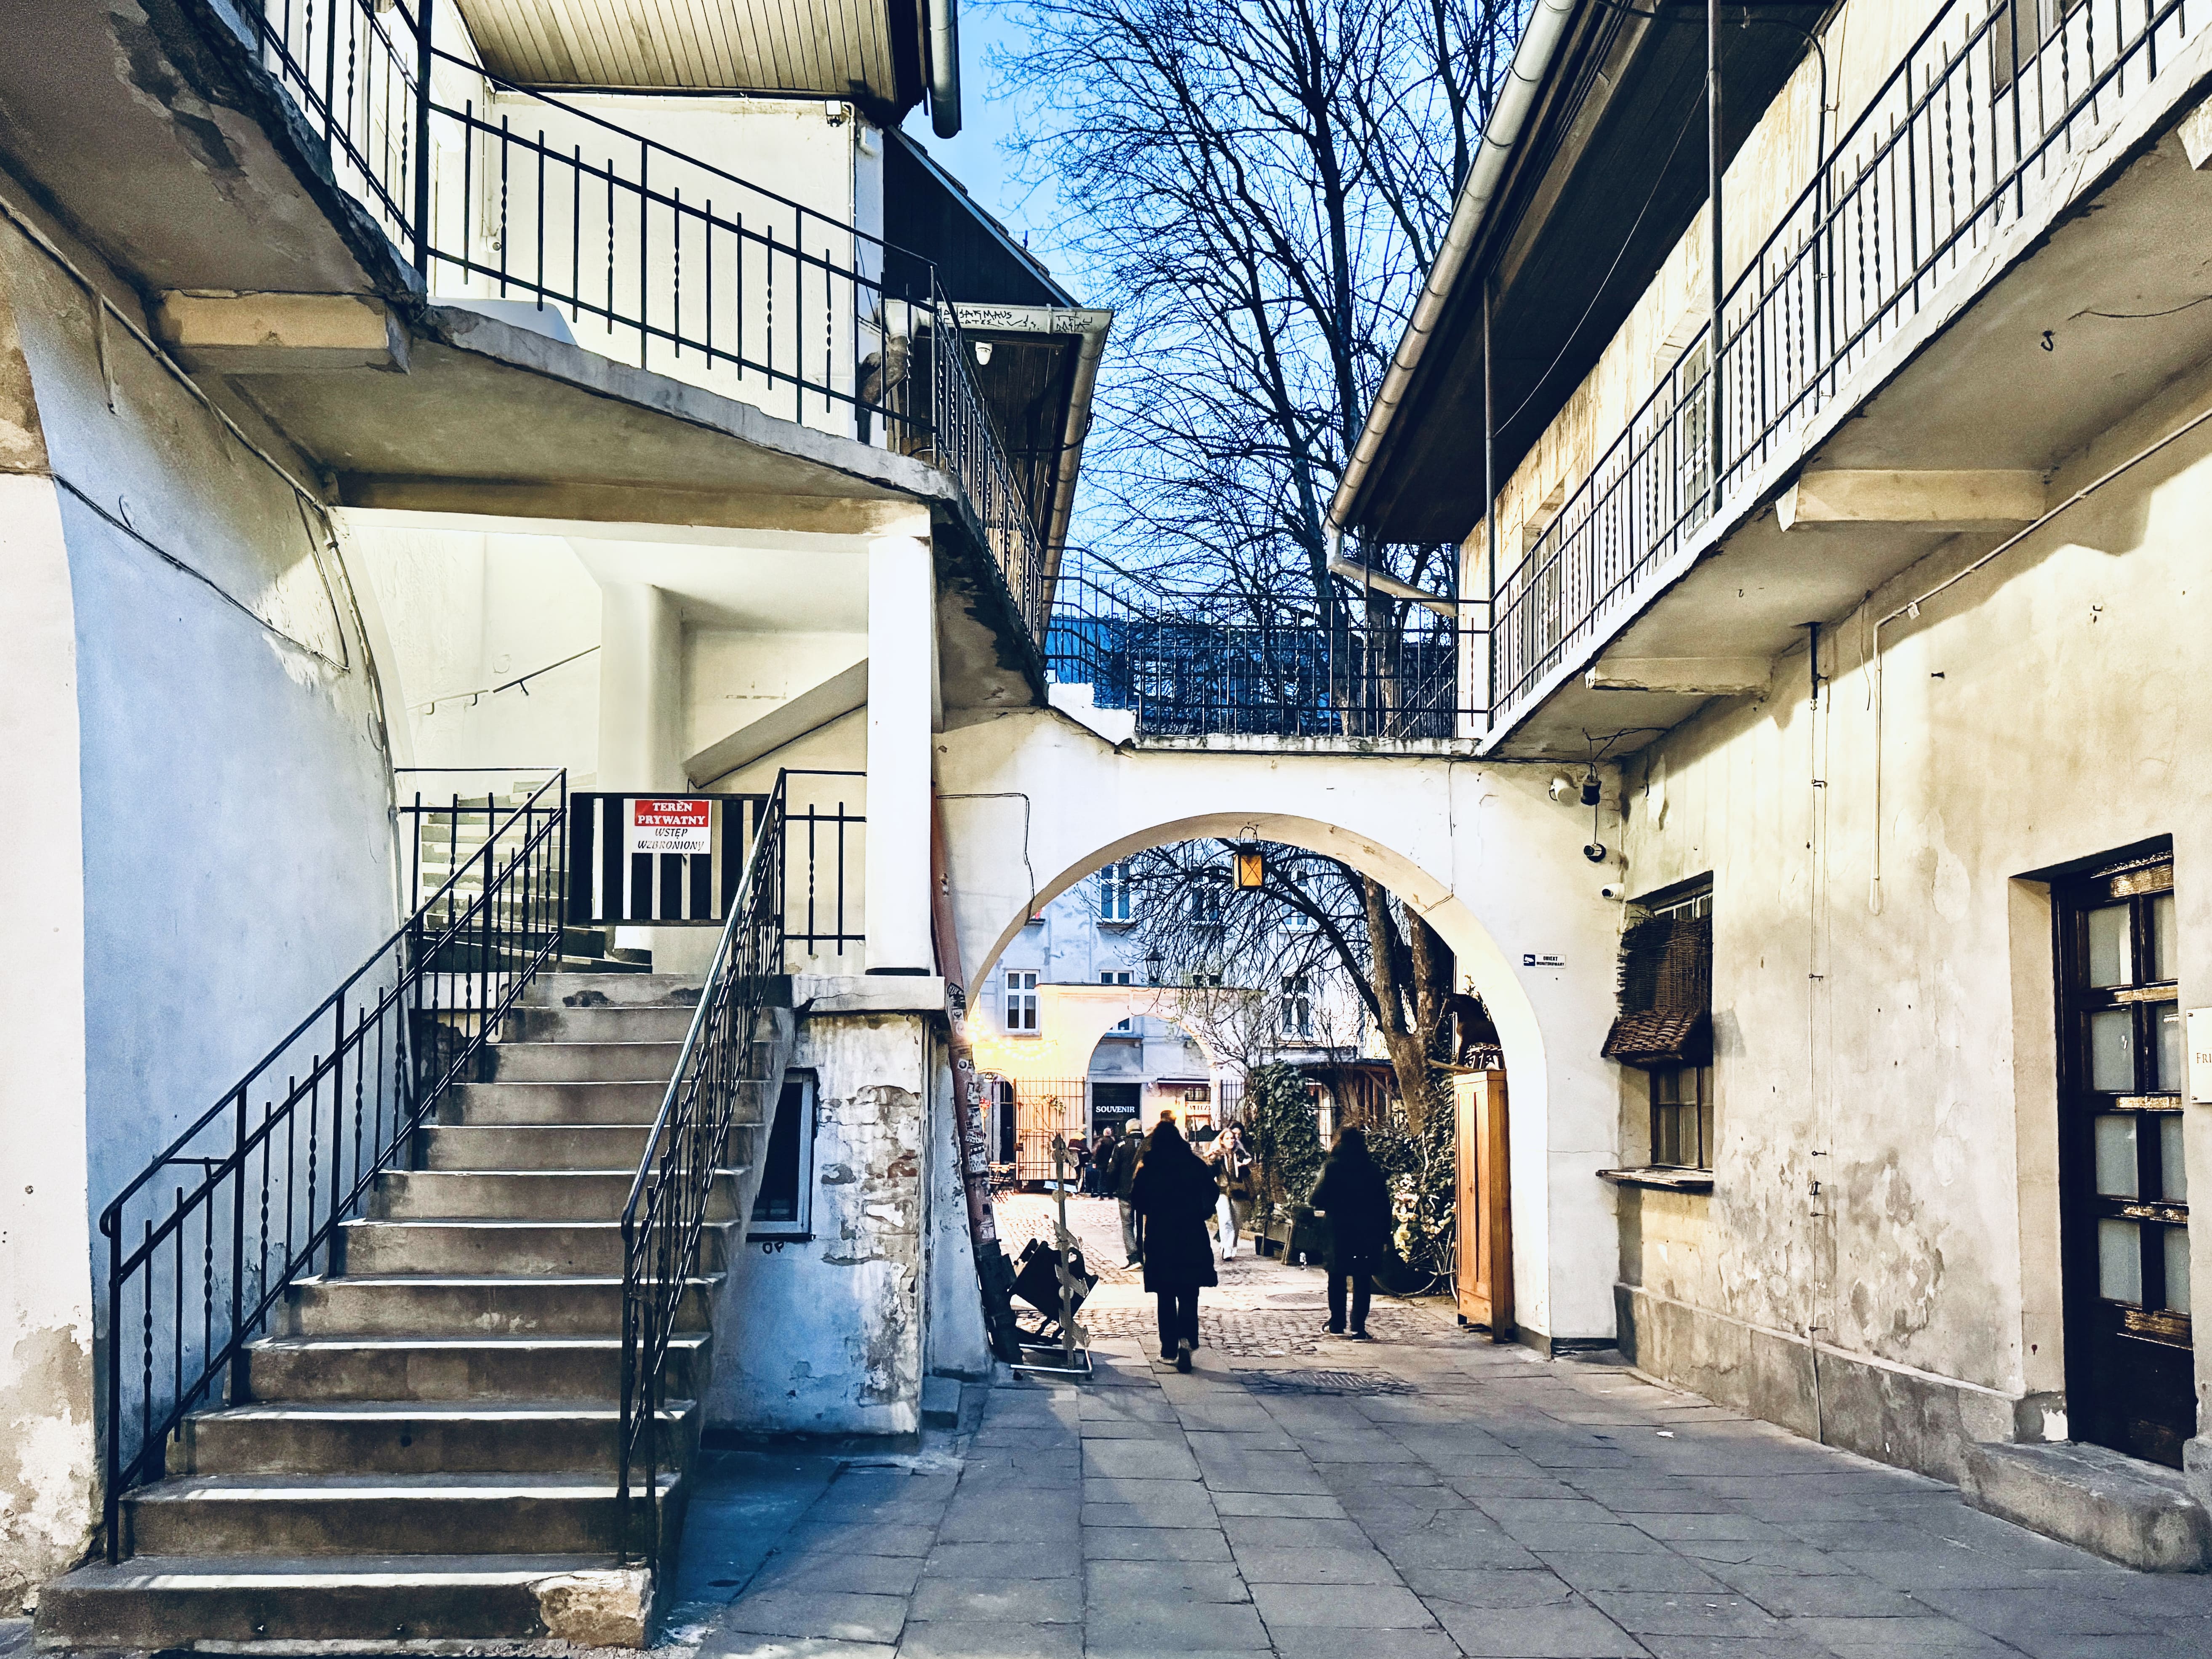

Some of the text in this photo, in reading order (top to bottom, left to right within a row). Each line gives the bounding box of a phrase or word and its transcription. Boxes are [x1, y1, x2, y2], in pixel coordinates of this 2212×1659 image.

[653, 802, 693, 812] TEREN
[637, 815, 706, 825] PRYWATNY
[655, 828, 688, 839] WSTĘP
[637, 840, 704, 851] WZBRONIONY
